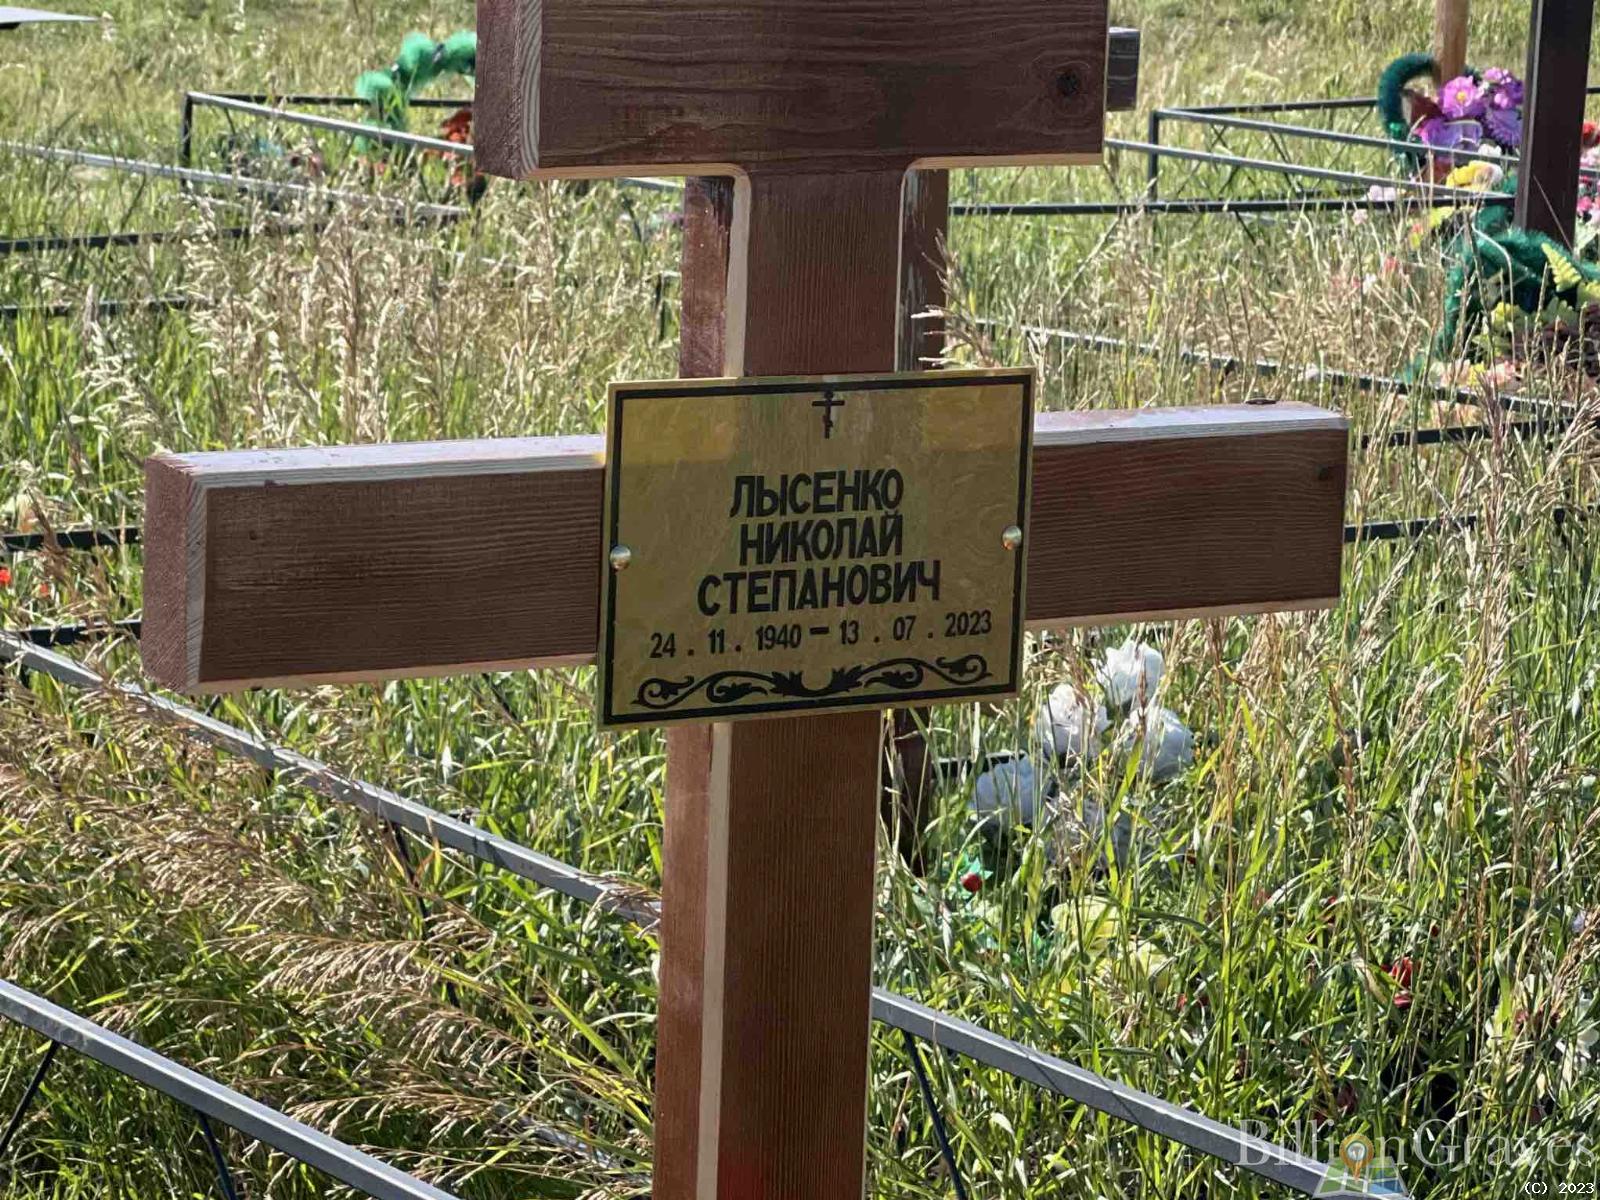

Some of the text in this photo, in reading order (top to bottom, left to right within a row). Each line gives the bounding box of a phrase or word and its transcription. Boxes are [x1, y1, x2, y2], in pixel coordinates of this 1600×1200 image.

[729, 468, 905, 519] ЛЫСЕНКО
[738, 509, 904, 567] НИКОЛАЙ
[696, 559, 942, 617] СТЕПАНОВИЧ
